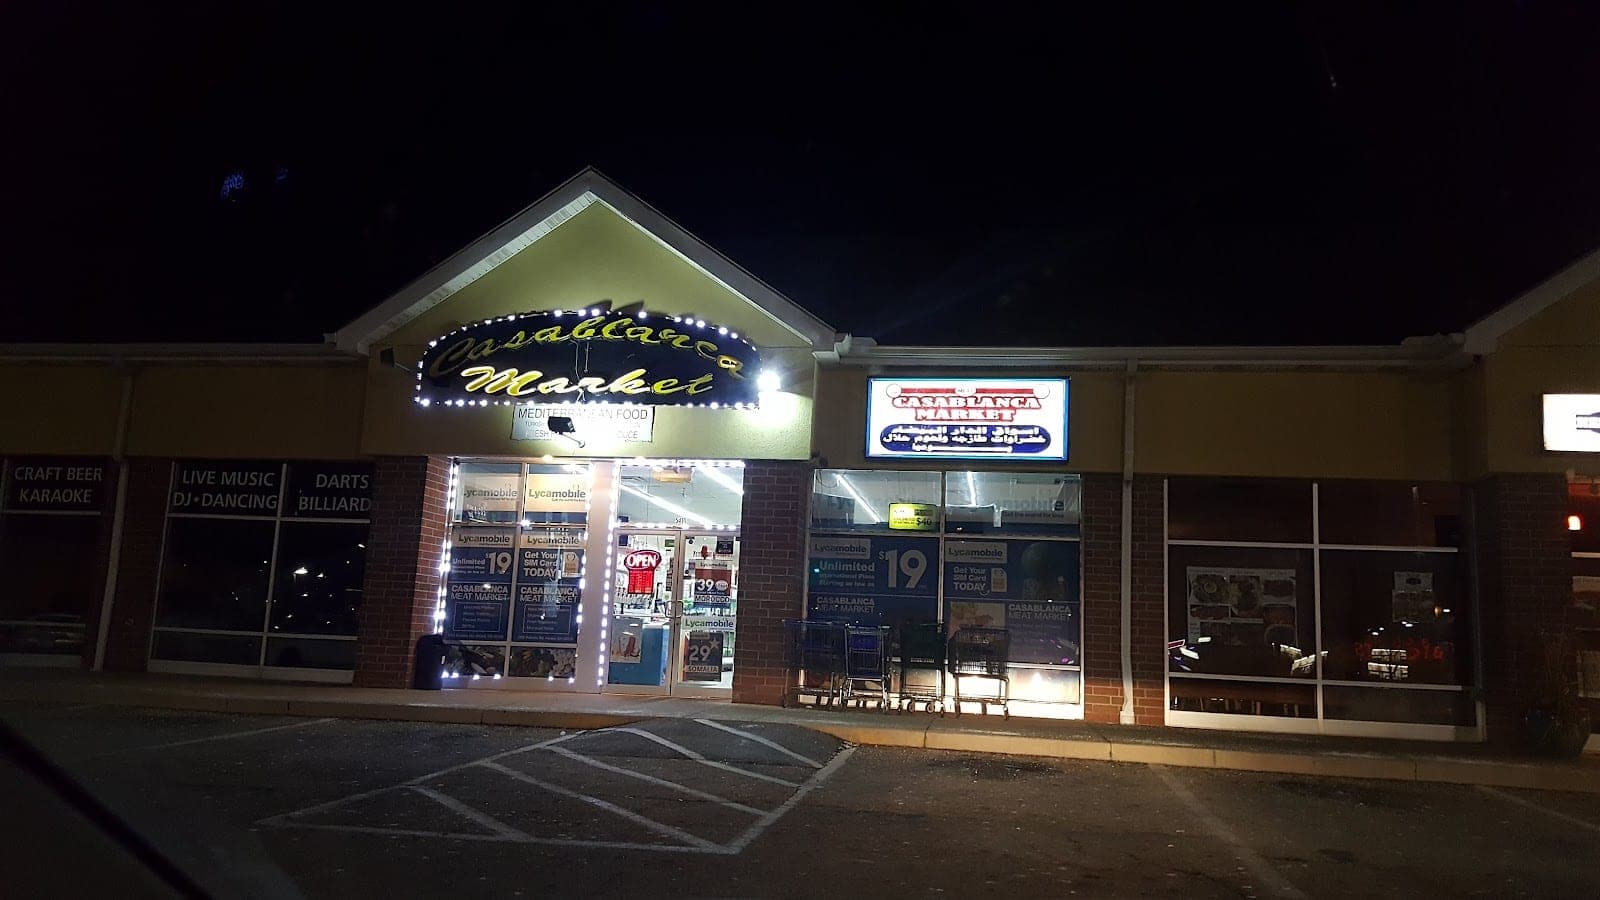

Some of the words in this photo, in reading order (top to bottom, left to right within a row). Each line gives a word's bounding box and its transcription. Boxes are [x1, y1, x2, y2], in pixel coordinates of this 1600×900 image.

[461, 366, 713, 396] Market
[892, 396, 1042, 409] CASABLANCA
[616, 408, 648, 420] FOOD
[915, 408, 1017, 421] MARKET
[14, 466, 64, 481] CRAFT
[67, 467, 102, 482] BEER
[182, 469, 217, 485] LIVE
[221, 471, 274, 487] MUSIC
[315, 474, 369, 490] DARTS
[19, 488, 92, 503] KARAOKE
[528, 488, 586, 499] Lycamobile
[458, 534, 511, 545] Lycamobile
[527, 535, 580, 546] Lycamobile
[815, 543, 867, 553] Lycamobile
[948, 547, 1003, 557] Lycamobile
[524, 551, 538, 560] Get
[541, 552, 557, 560] Your
[452, 558, 486, 566] Unlimited
[524, 559, 538, 567] SIM
[540, 559, 558, 567] Card
[627, 554, 656, 568] OPEN
[820, 561, 875, 572] Unlimited
[879, 549, 928, 589] $19
[953, 566, 968, 574] Get
[970, 566, 986, 574] Your
[524, 568, 557, 578] TODAY
[451, 584, 509, 594] CASABLANCA
[697, 578, 715, 592] 39
[953, 582, 986, 591] TODAY
[520, 586, 578, 596] CASABLANCA
[450, 593, 475, 601] MEAT
[478, 593, 509, 601] MARKET
[520, 594, 541, 603] MEAT
[543, 594, 578, 603] MARKET
[695, 595, 730, 603] MOROCCO
[816, 597, 875, 606] CASABLANCA
[840, 605, 875, 613] MARKET
[1008, 603, 1071, 613] CASABLANCA
[1008, 611, 1031, 619] MEAT
[1034, 612, 1071, 621] MARKET
[685, 620, 734, 629] Lycamobile
[689, 645, 711, 661] 29
